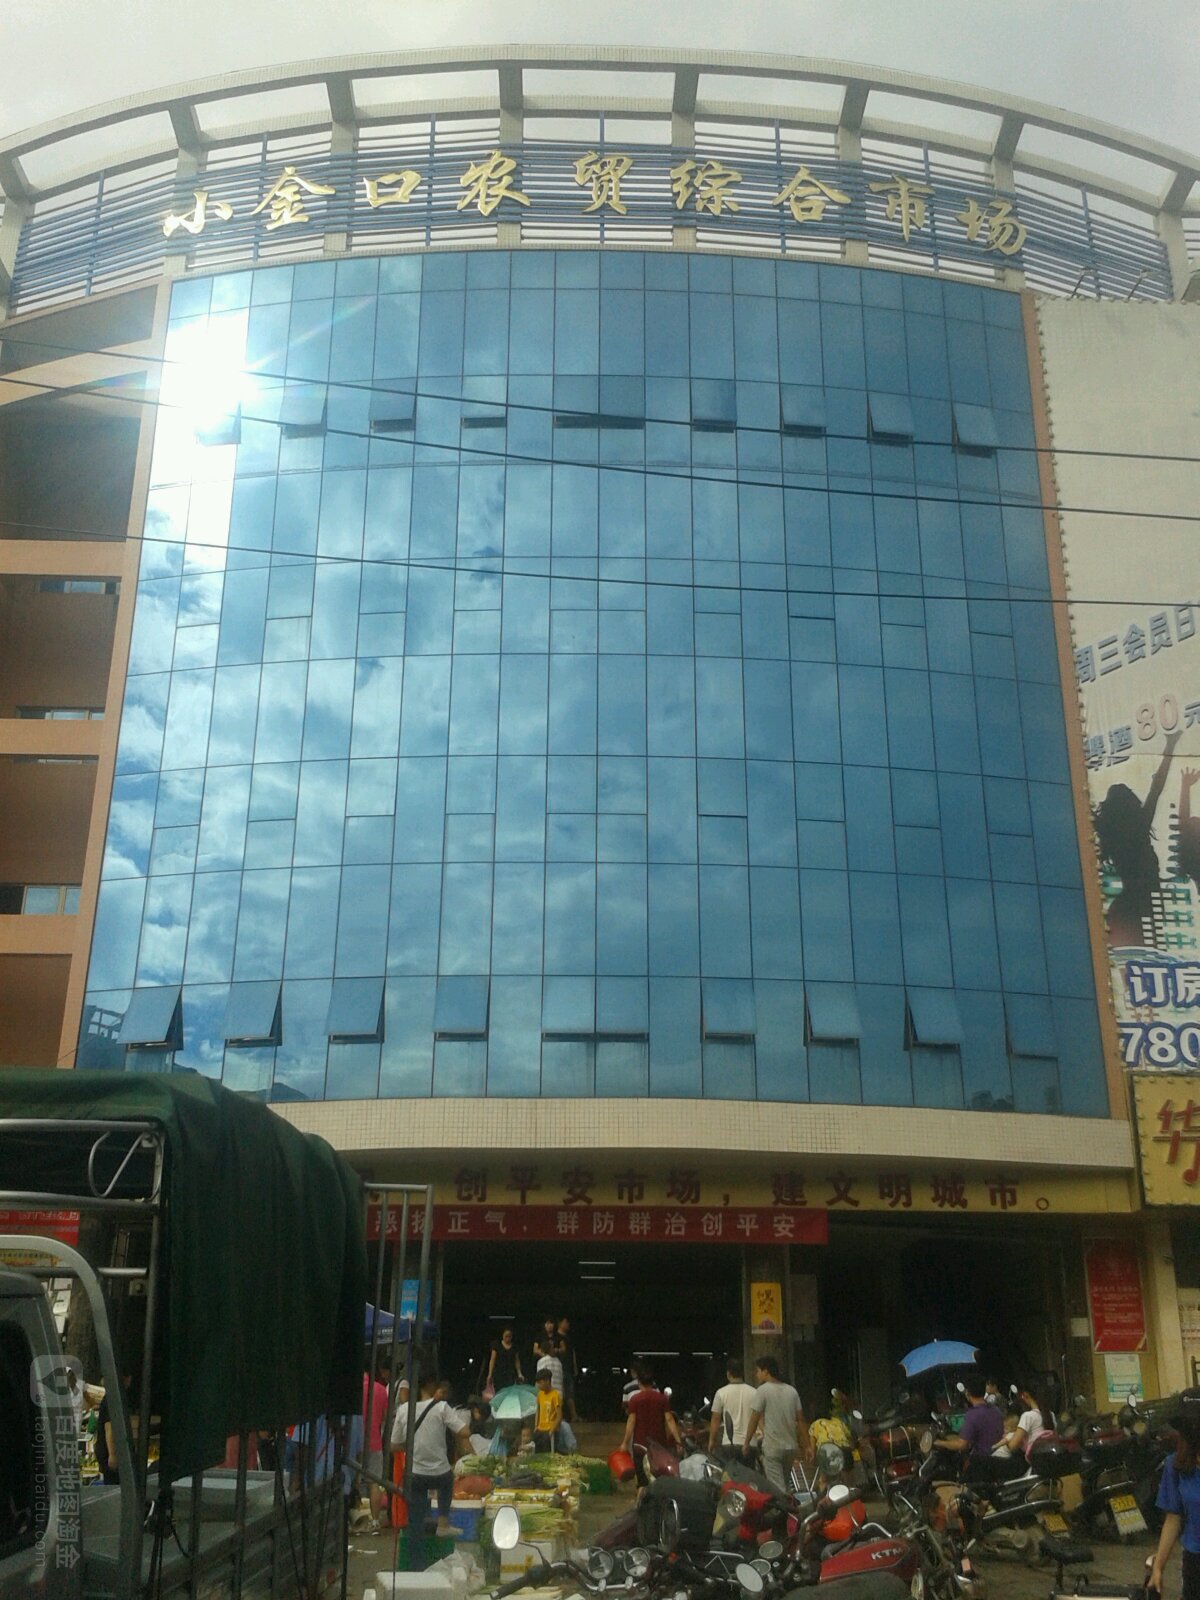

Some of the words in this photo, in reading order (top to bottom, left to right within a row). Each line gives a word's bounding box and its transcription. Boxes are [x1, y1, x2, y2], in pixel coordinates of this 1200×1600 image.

[162, 150, 1028, 256] 小金口农贸综合市场
